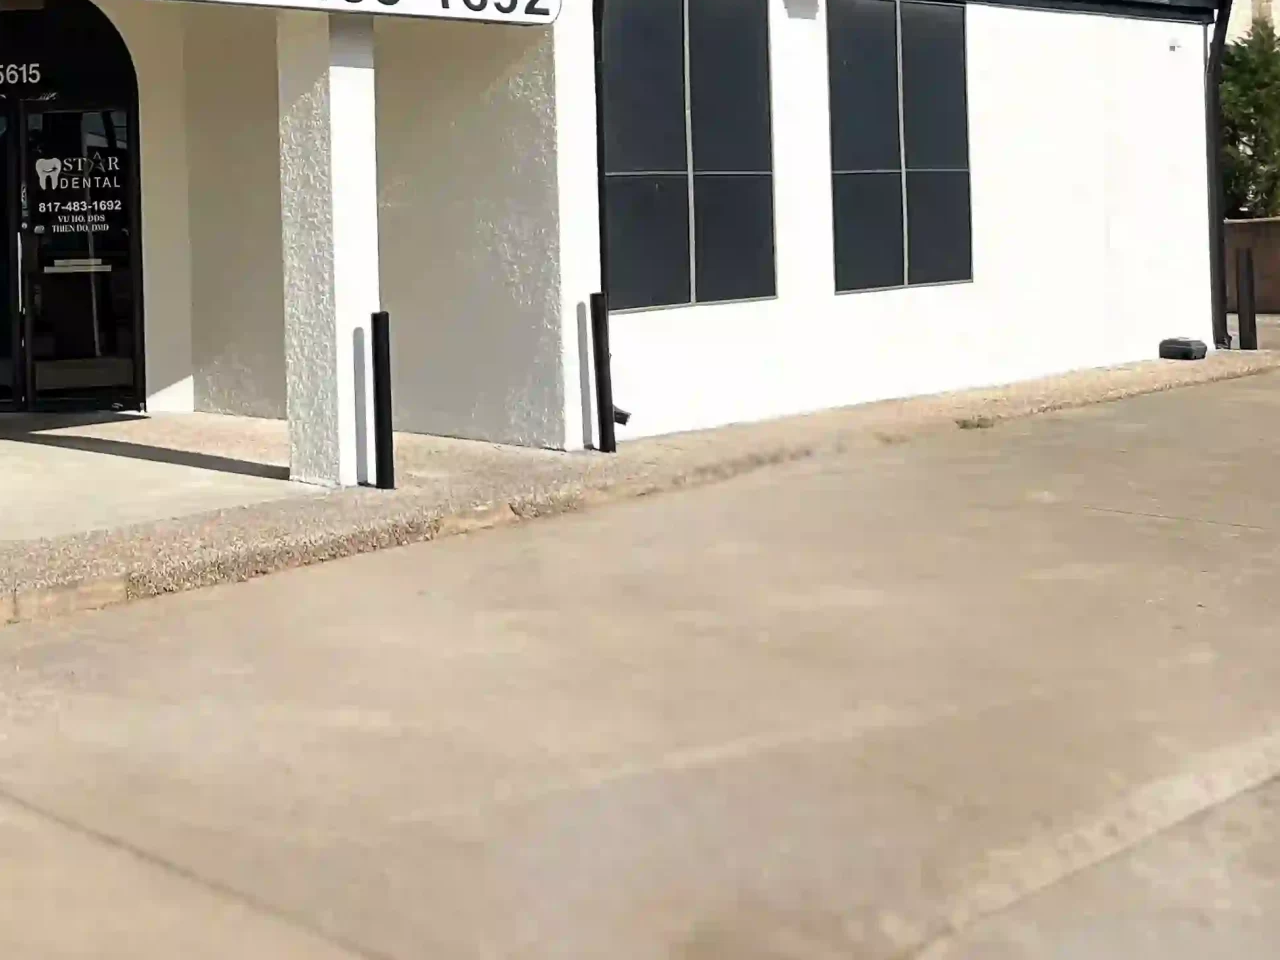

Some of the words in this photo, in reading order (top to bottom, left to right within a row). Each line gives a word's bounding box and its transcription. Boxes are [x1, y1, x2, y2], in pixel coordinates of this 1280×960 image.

[60, 176, 121, 189] DENTAL
[38, 200, 122, 213] 817-483-1692
[88, 214, 106, 222] DDS
